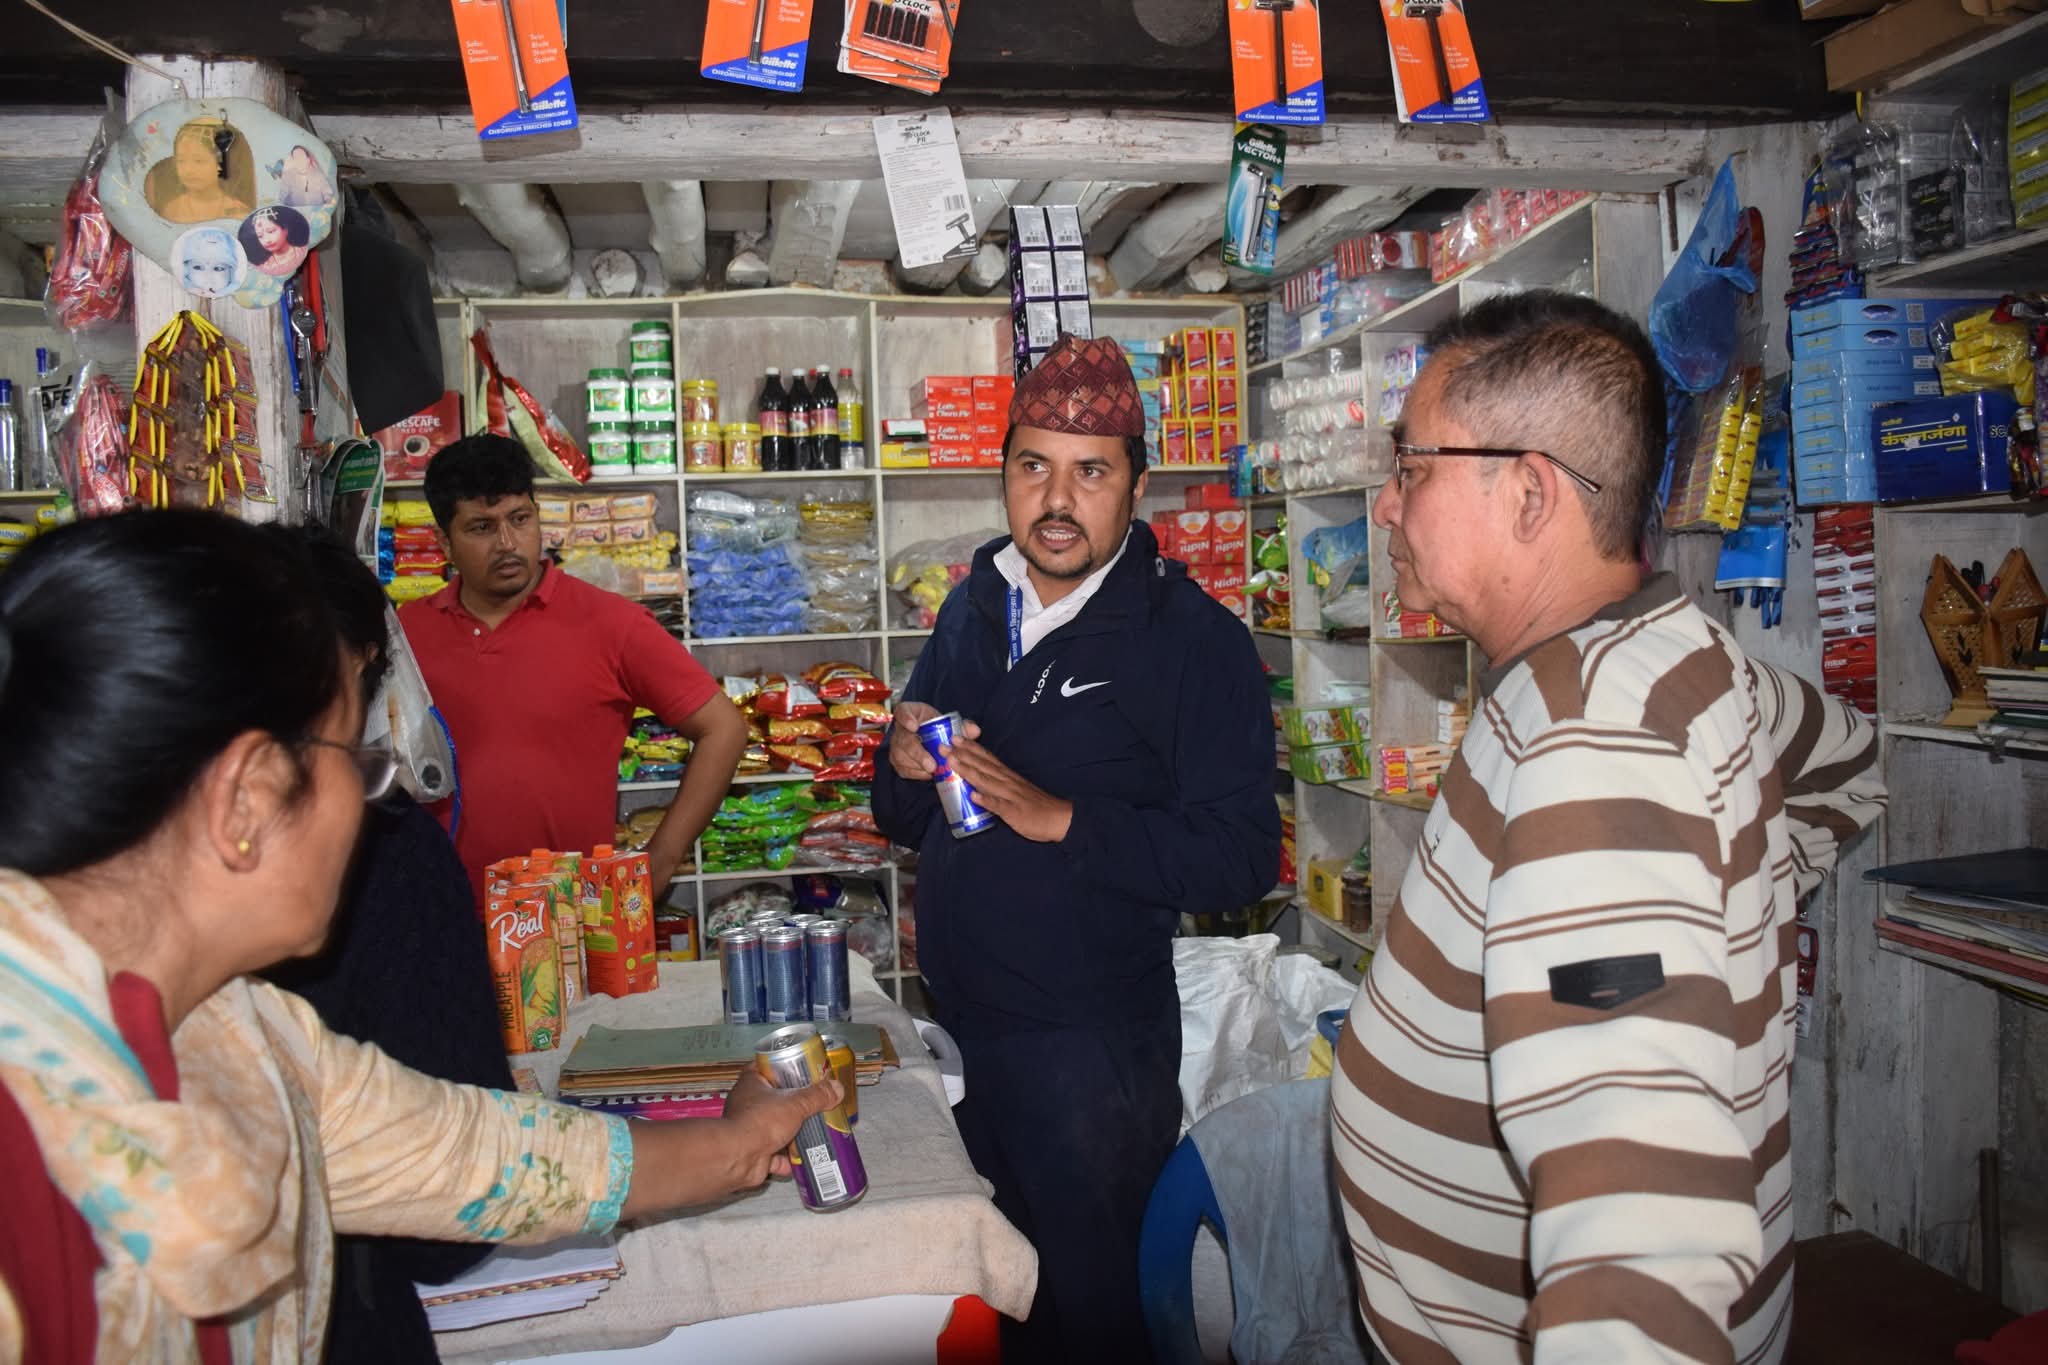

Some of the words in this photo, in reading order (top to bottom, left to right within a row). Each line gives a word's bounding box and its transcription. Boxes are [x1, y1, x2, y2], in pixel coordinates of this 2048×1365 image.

[761, 56, 799, 69] Gillette
[530, 98, 567, 111] Gillette
[1453, 96, 1480, 105] illette
[1248, 137, 1278, 155] Gillette
[1214, 576, 1243, 589] Nidhi
